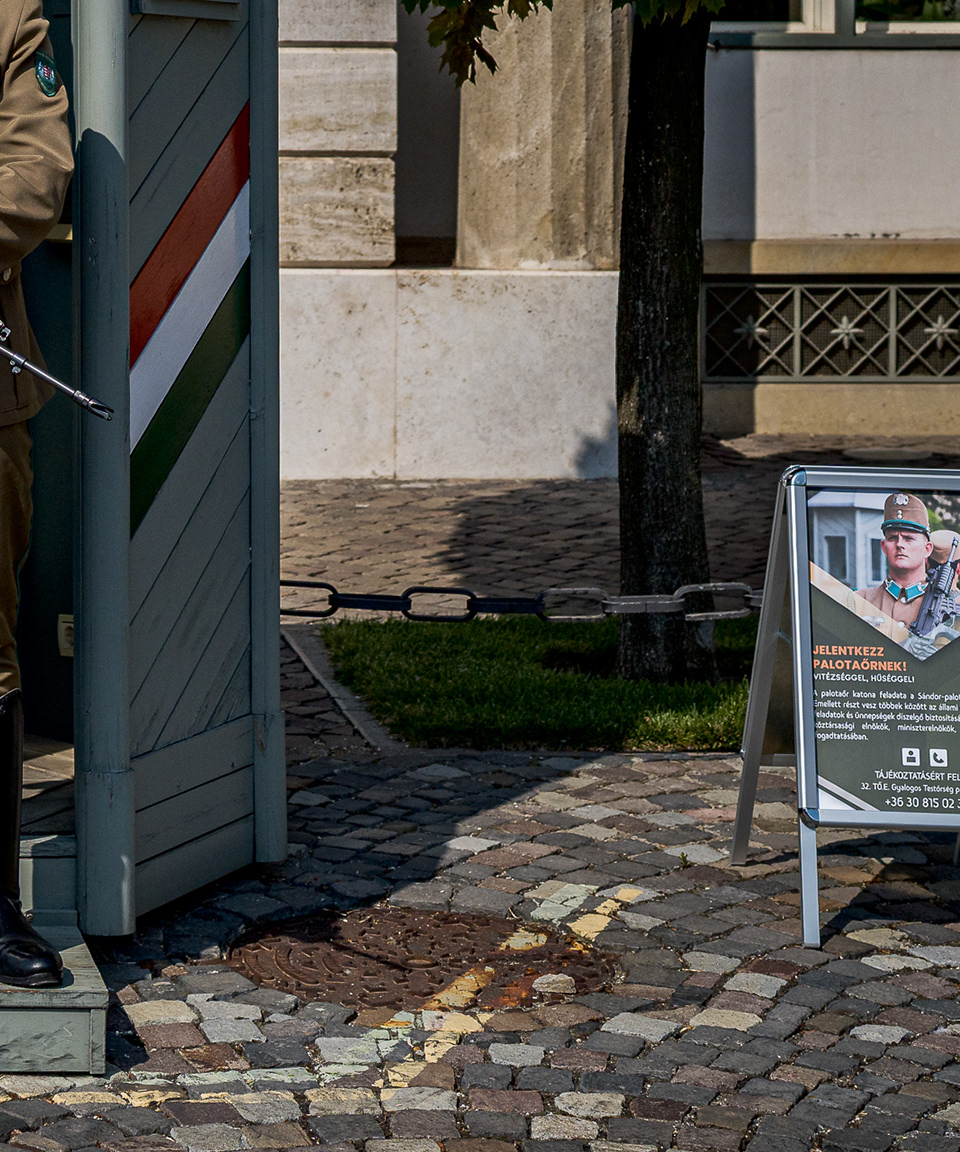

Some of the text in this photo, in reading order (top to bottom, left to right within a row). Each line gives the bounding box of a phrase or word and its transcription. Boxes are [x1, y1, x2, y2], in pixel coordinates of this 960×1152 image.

[813, 645, 884, 657] JELENTKEZZ
[813, 659, 907, 671] PALOTAŐRNEK!
[813, 672, 869, 682] VITÉZSÉGGEL,
[821, 690, 849, 699] palotaőr
[852, 690, 876, 698] katona
[879, 691, 907, 699] feladata
[843, 701, 860, 709] részt
[904, 702, 927, 711] között
[939, 703, 959, 711] állami
[815, 710, 845, 719] eladatok
[855, 712, 895, 722] ünnepségek
[861, 722, 891, 731] elnökök,
[815, 732, 869, 741] ogadtatásában.
[874, 769, 945, 781] TÁJÉKOZTATÁSÉRT
[861, 782, 871, 790] 32.
[891, 783, 922, 793] Gyalogos
[923, 784, 954, 794] Testőrség
[885, 796, 904, 807] +36
[906, 797, 920, 808] 30
[922, 797, 939, 808] 815
[942, 798, 955, 809] 02
